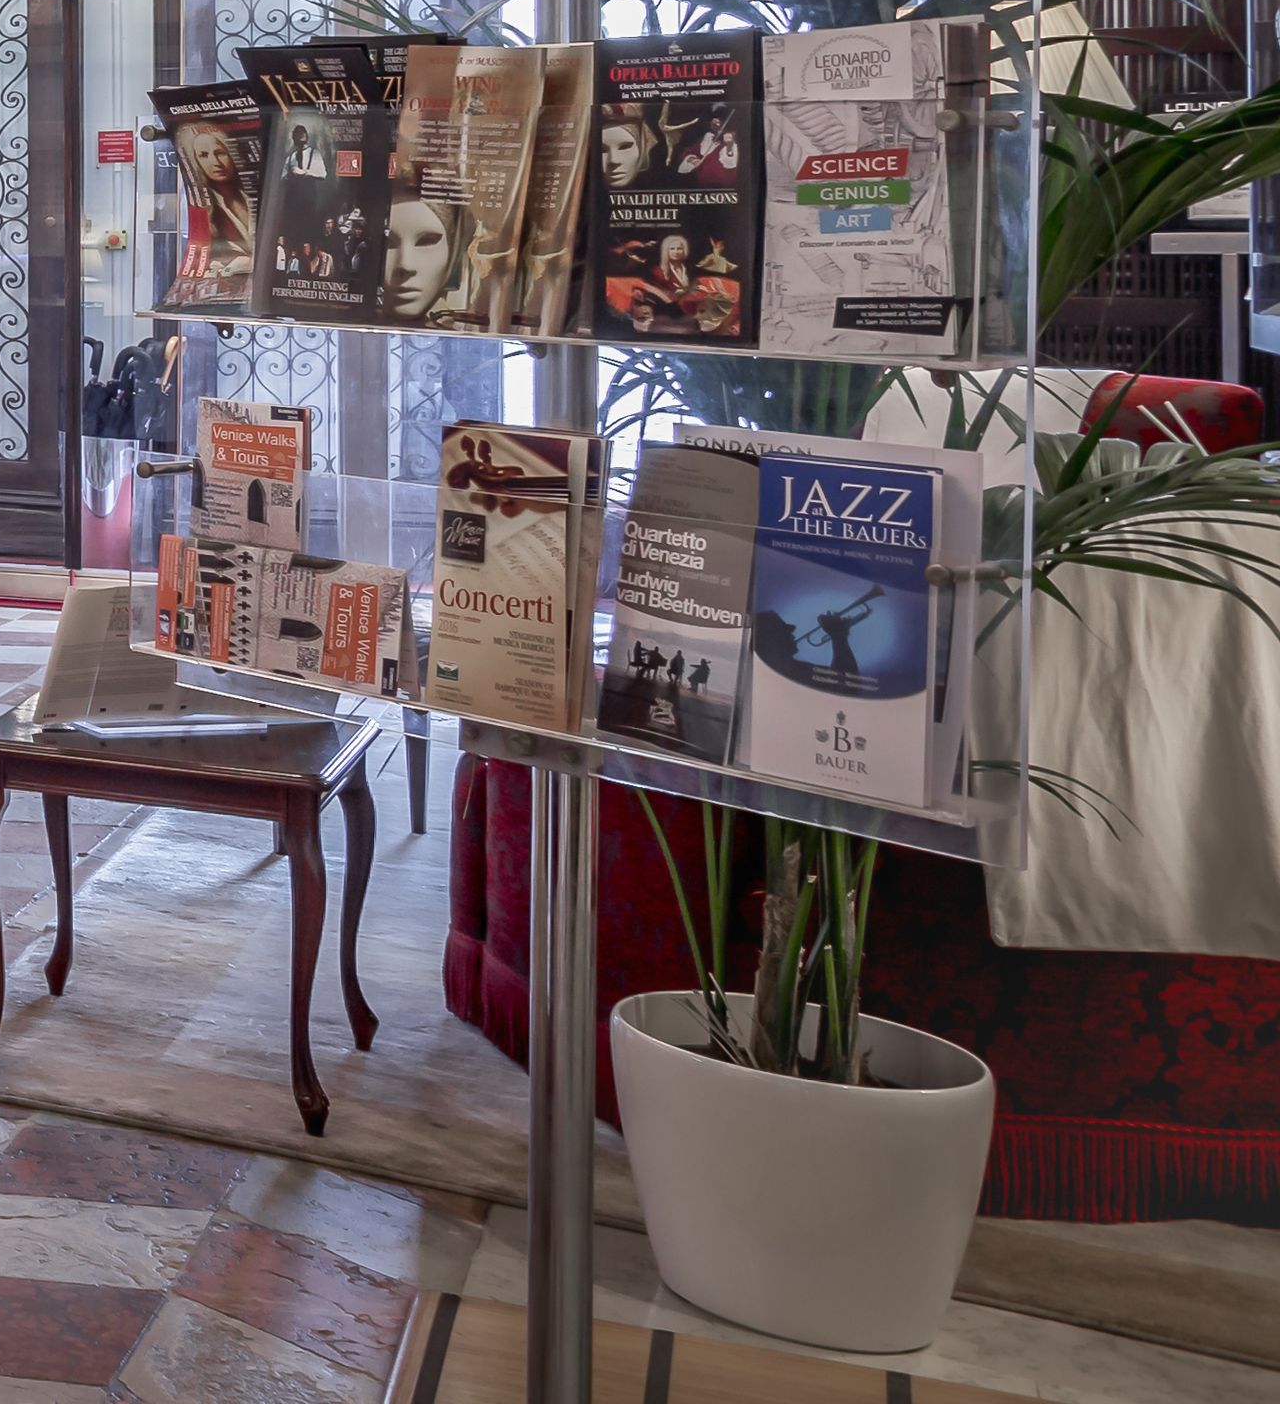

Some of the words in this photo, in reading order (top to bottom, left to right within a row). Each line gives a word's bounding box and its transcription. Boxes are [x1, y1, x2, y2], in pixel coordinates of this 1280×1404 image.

[814, 49, 891, 69] LEONARDO
[609, 66, 660, 82] OPERA
[662, 61, 740, 79] BALLETTO
[823, 67, 846, 82] DA
[848, 64, 883, 79] VINCI
[260, 74, 368, 114] VENEZIA
[619, 82, 656, 90] Orchestra
[657, 81, 684, 90] Singers
[701, 78, 728, 86] Dancer
[661, 90, 689, 98] century
[691, 88, 725, 96] costumes
[831, 79, 870, 90] MUSEUM
[169, 103, 201, 116] CHIESA
[200, 100, 229, 112] DELLA
[810, 156, 899, 175] SCIENCE
[609, 194, 653, 206] VIVALDI
[656, 193, 687, 205] FOUR
[689, 192, 738, 205] SEASONS
[819, 185, 890, 202] GENIUS
[610, 209, 633, 221] AND
[634, 208, 679, 220] BALLET
[835, 213, 872, 228] ART
[799, 240, 835, 248] Discover
[836, 239, 876, 247] Leonardo
[877, 238, 889, 246] da
[287, 278, 312, 289] EVERY
[312, 279, 349, 292] EVENING
[272, 287, 318, 300] PERFORMED
[318, 289, 328, 300] IN
[329, 291, 364, 304] ENGLISH
[843, 302, 877, 310] Leonardo
[213, 426, 254, 443] Venice
[257, 431, 297, 448] Walks
[216, 446, 227, 461] &
[230, 448, 270, 467] Tours
[778, 475, 913, 528] JAZZ
[811, 506, 824, 517] at
[624, 520, 708, 552] Quartetto
[789, 516, 833, 538] THE
[621, 538, 638, 557] di
[639, 541, 705, 571] Venezia
[772, 539, 840, 557] INTERNATIONAL
[843, 550, 871, 561] MUSIC
[874, 554, 914, 566] FESTIVAL
[617, 565, 680, 598] Ludwig
[339, 587, 354, 599] &
[440, 578, 554, 625] Concerti
[358, 586, 375, 636] Venice
[616, 587, 646, 606] van
[648, 589, 743, 627] Beethoven
[335, 605, 353, 649] Tours
[493, 636, 520, 649] MUSICA
[353, 638, 372, 683] Walks
[833, 725, 852, 753] B
[815, 753, 868, 775] BAUER
